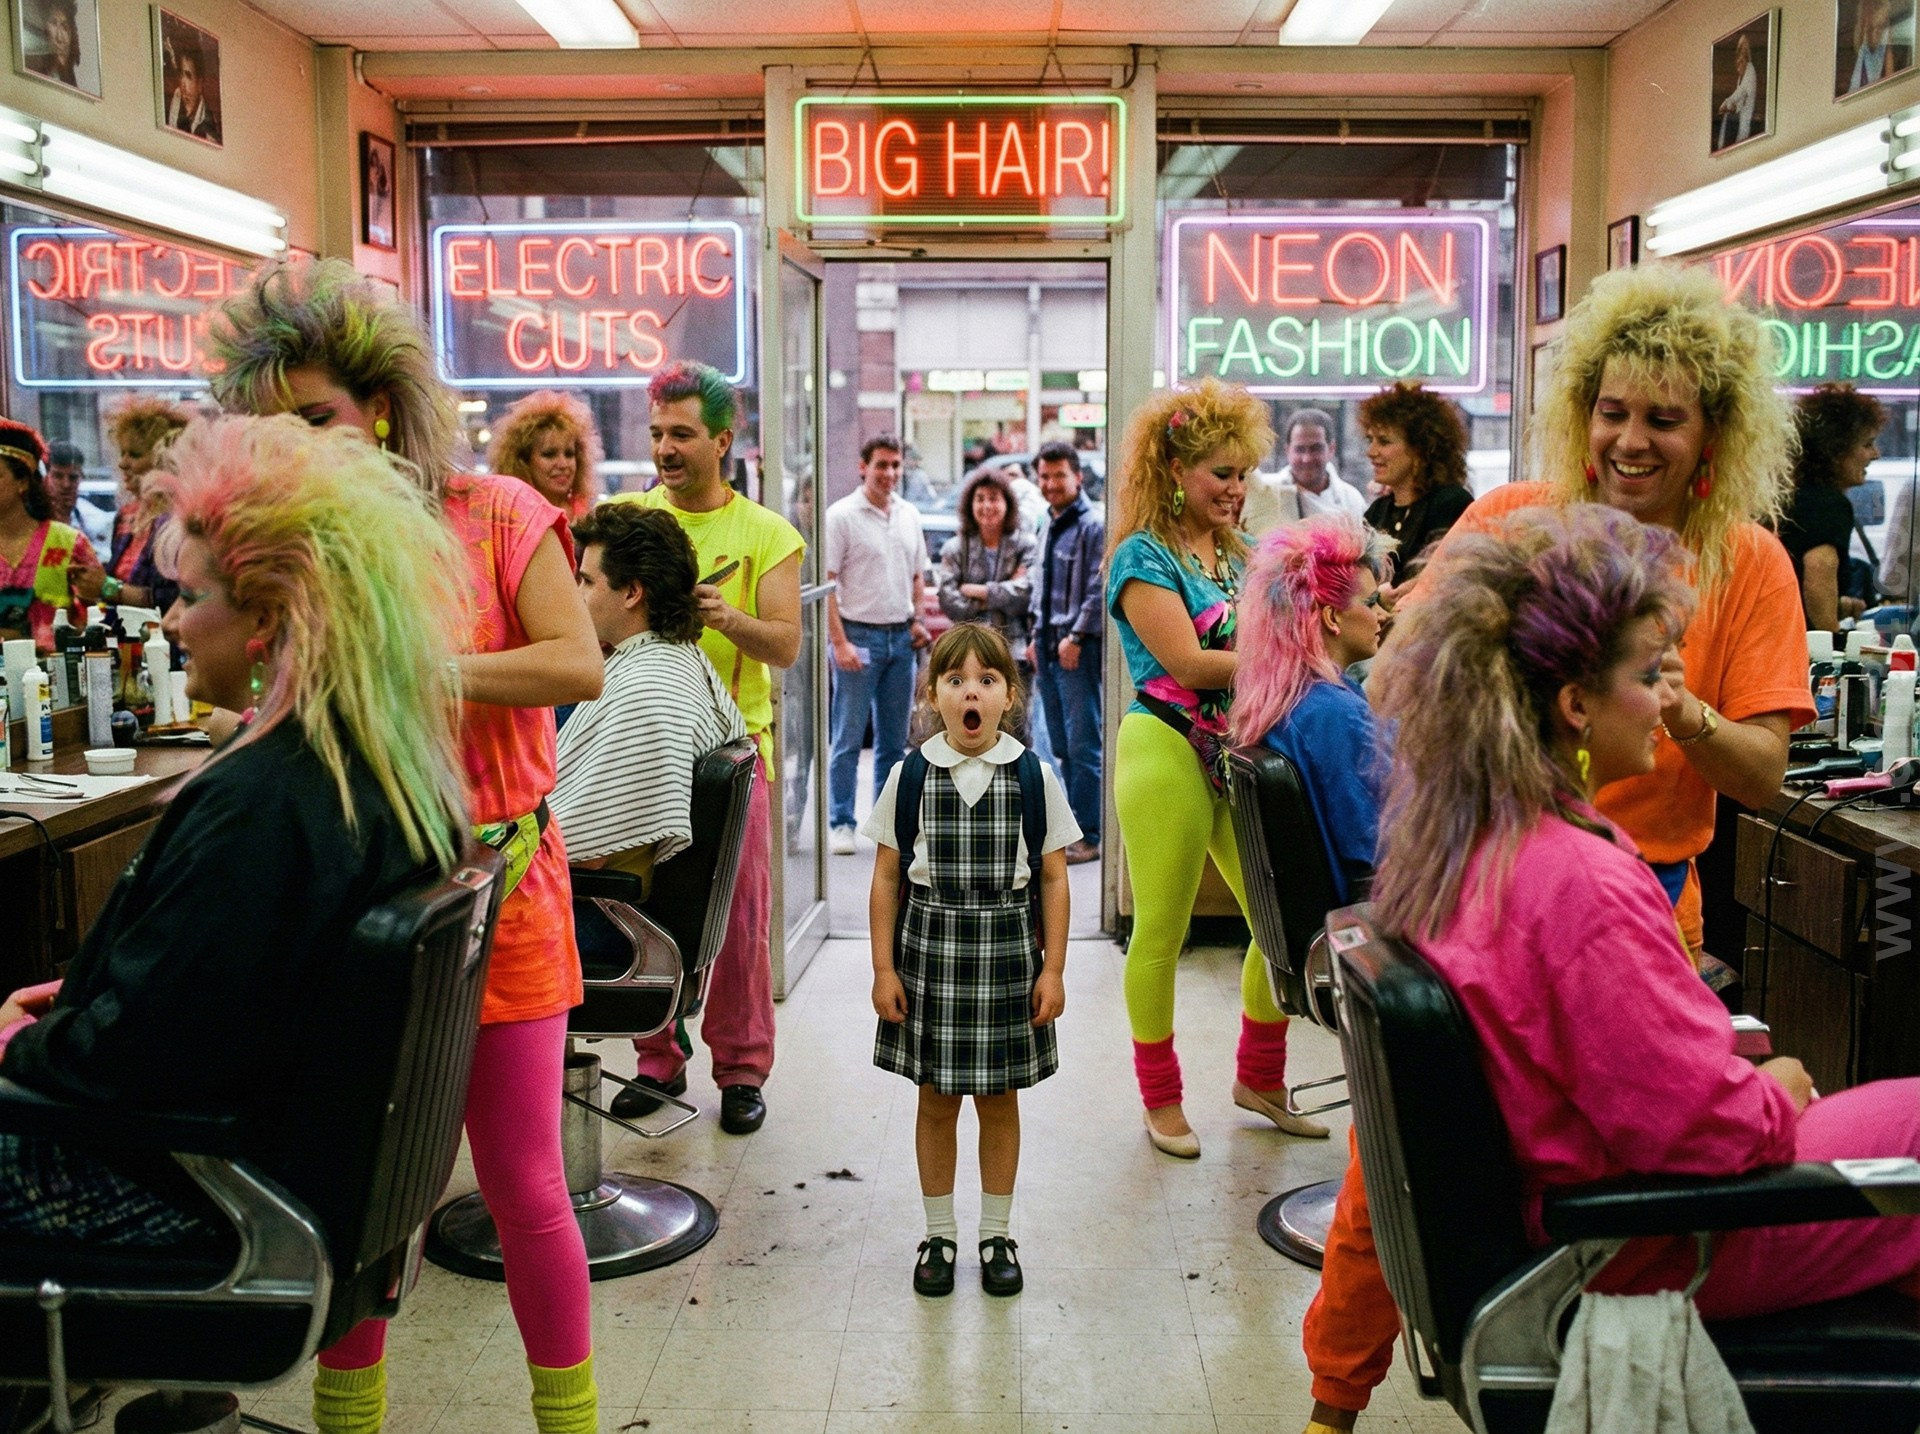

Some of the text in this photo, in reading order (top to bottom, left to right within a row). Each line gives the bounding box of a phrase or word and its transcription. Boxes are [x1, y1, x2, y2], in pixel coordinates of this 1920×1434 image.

[813, 120, 1110, 197] BIG HAIR!
[448, 235, 733, 297] ELECTRIC
[1205, 231, 1456, 306] NEON
[506, 309, 668, 371] CUTS
[1187, 315, 1473, 378] FASHION
